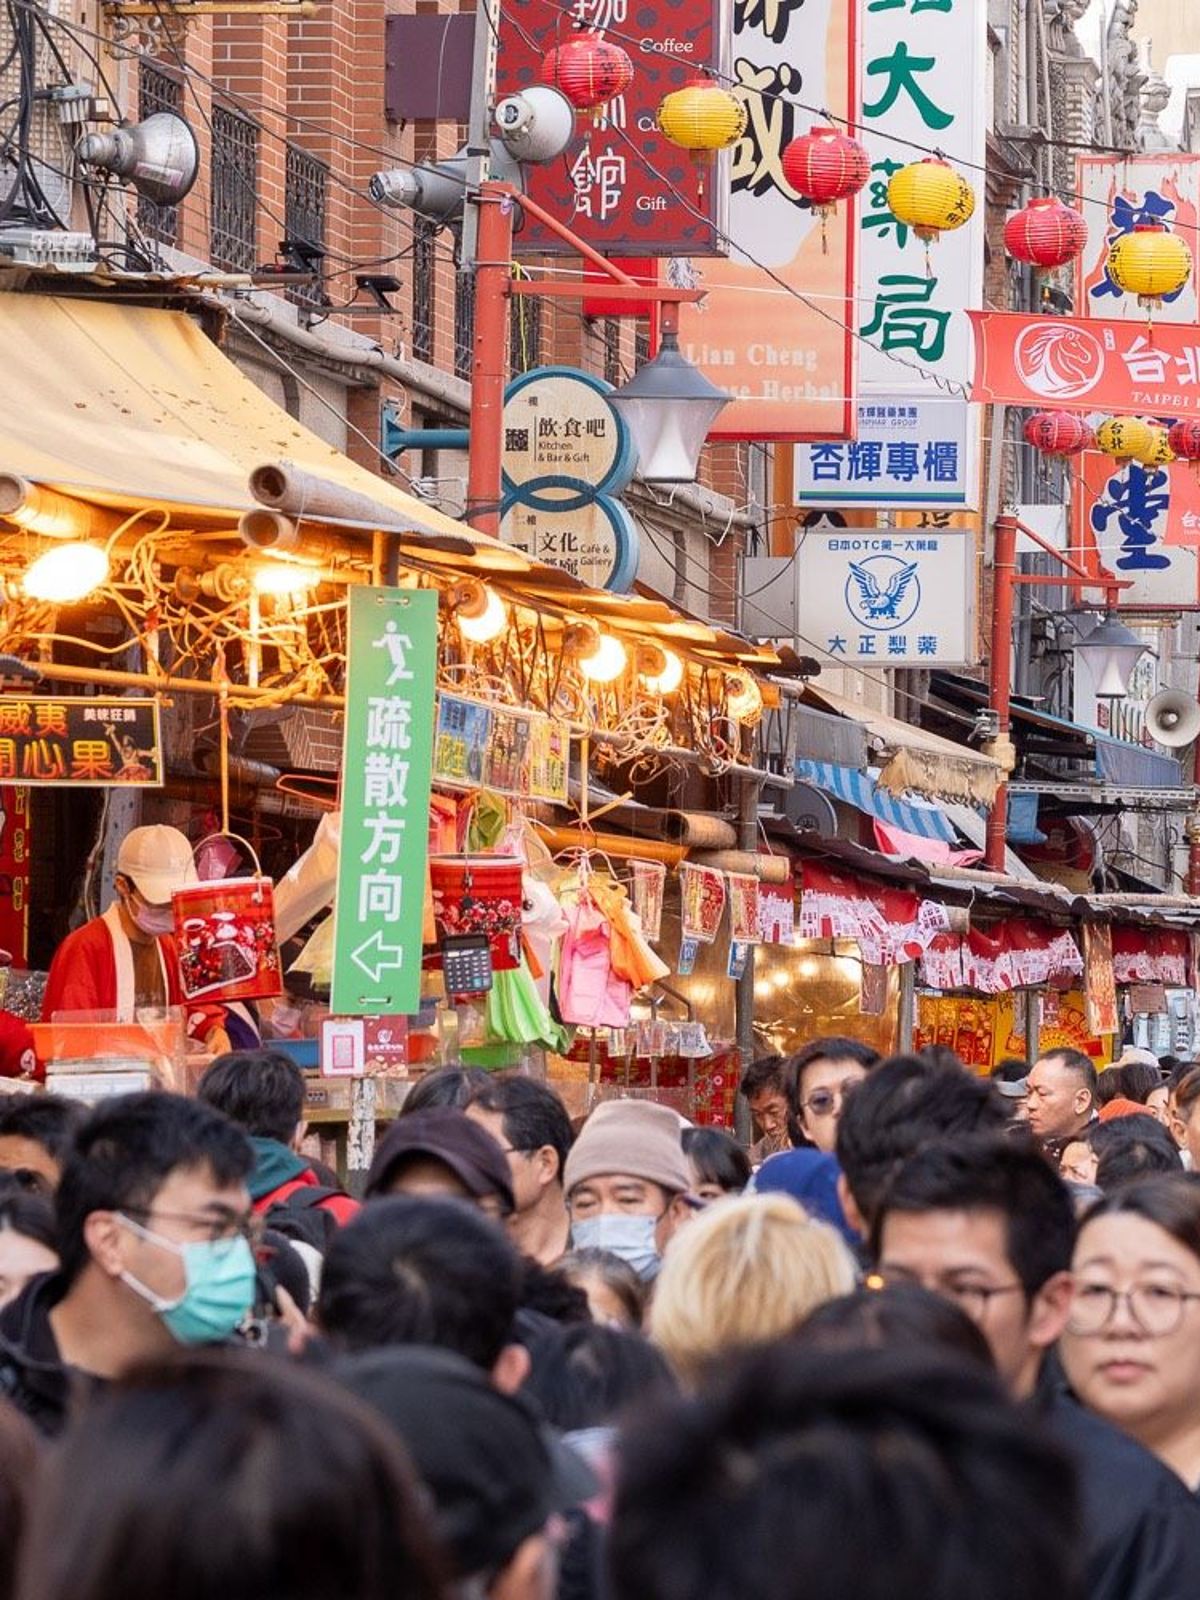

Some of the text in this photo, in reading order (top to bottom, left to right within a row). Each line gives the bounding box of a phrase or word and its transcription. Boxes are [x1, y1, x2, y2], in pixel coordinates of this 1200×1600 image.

[640, 37, 694, 53] Coffee
[636, 196, 667, 211] Gift
[686, 343, 817, 372] Lian Cheng
[1131, 391, 1189, 408] TAIPEI
[1110, 422, 1124, 449] 台北
[547, 453, 562, 462] Bar
[573, 452, 590, 462] Gift
[809, 441, 958, 482] 杏輝專櫃
[1090, 464, 1171, 570] 堂
[539, 532, 578, 553] 文化
[358, 695, 413, 923] 疏散方向
